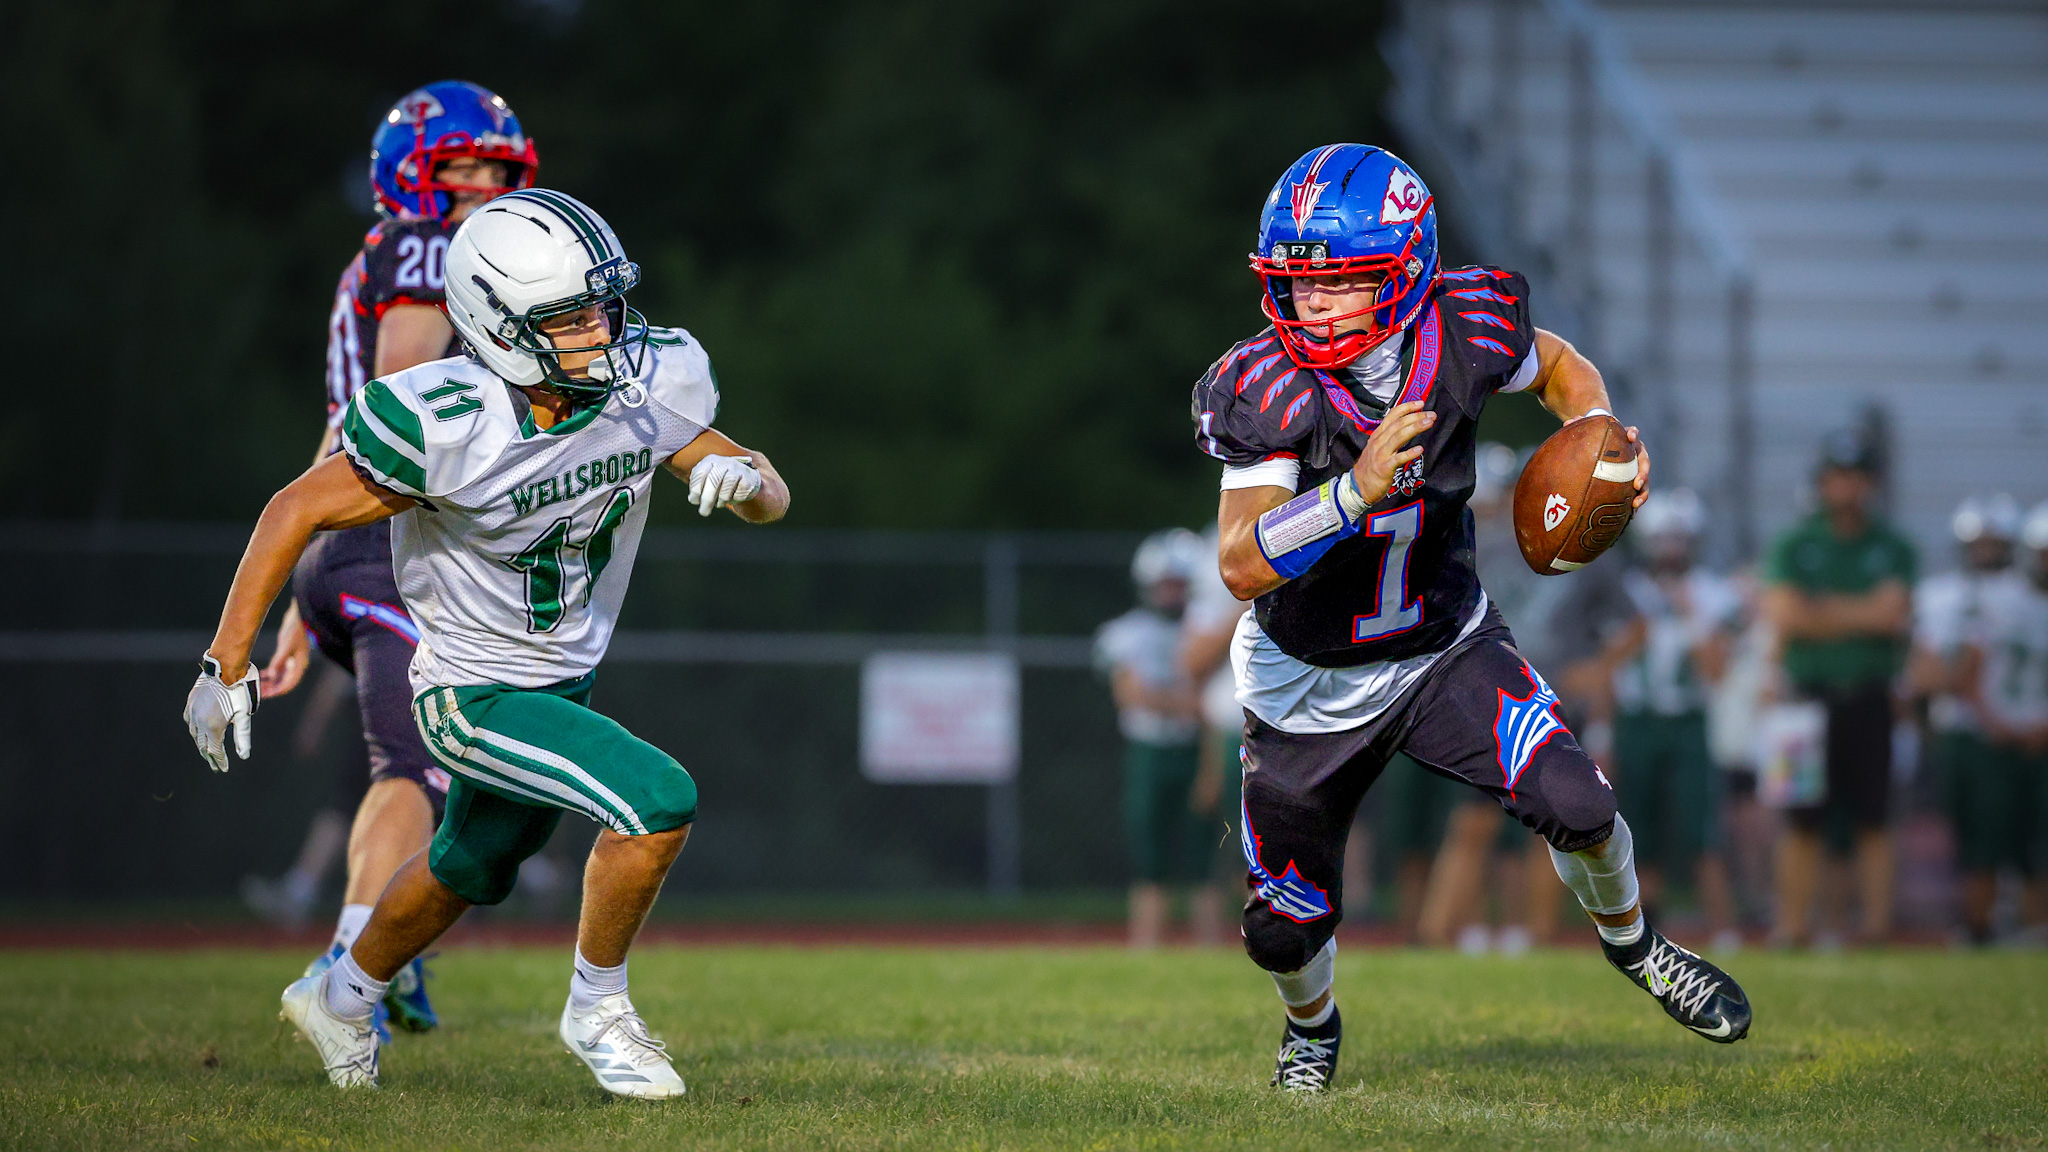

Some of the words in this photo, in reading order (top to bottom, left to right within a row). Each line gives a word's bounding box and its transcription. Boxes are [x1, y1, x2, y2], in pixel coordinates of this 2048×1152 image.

[395, 234, 450, 290] 20
[603, 266, 615, 279] F7
[1291, 245, 1306, 256] F7
[418, 377, 485, 422] 11
[1200, 410, 1230, 461] 1
[507, 446, 653, 516] WELLSBORO
[498, 485, 635, 634] 11
[1352, 498, 1424, 643] 1
